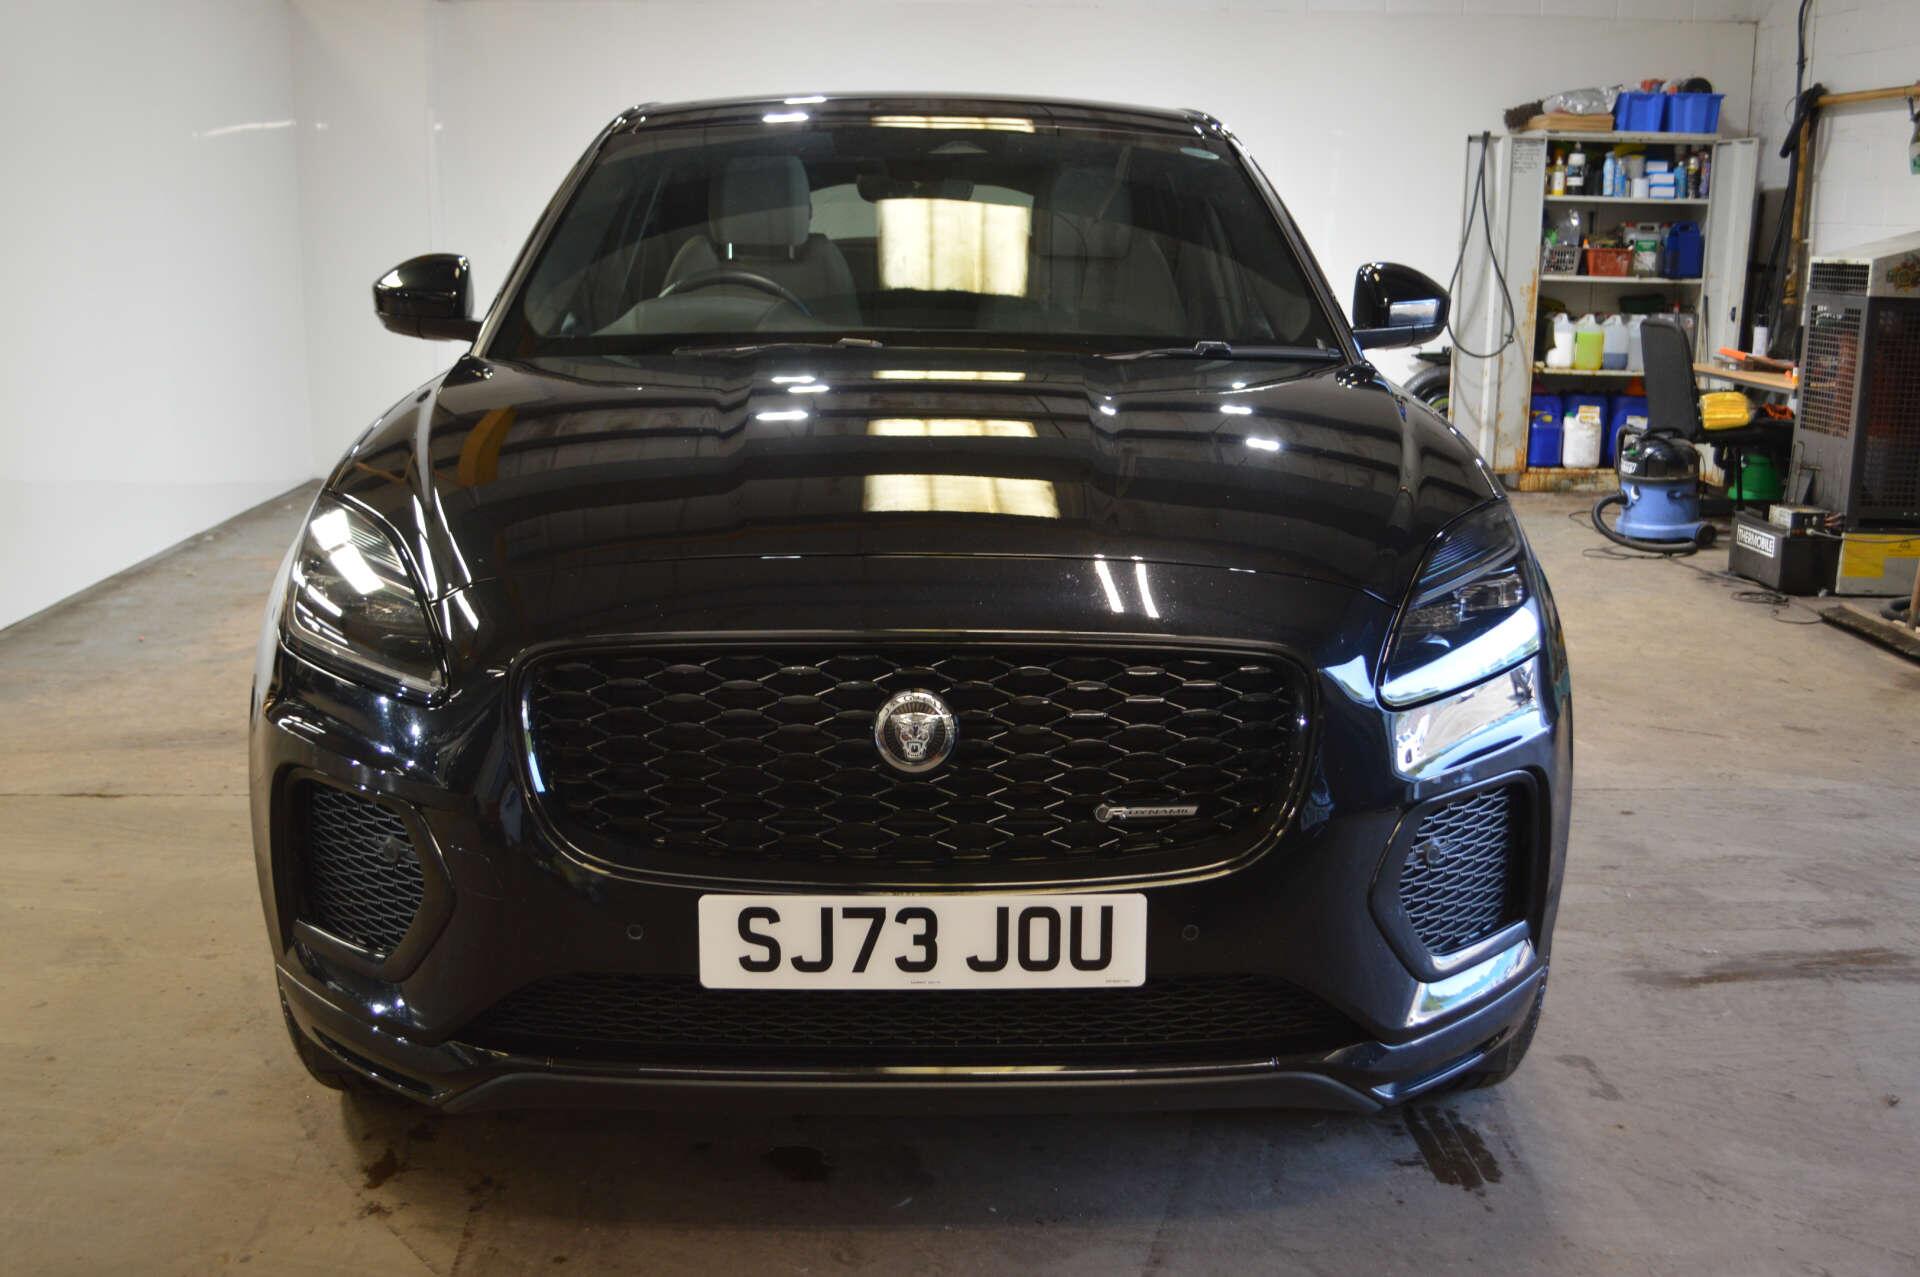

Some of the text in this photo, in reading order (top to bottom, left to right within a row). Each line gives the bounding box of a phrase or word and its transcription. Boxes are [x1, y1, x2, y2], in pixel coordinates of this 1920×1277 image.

[1738, 526, 1772, 553] THERMOBILE
[738, 906, 1113, 973] SJ73 JOU
